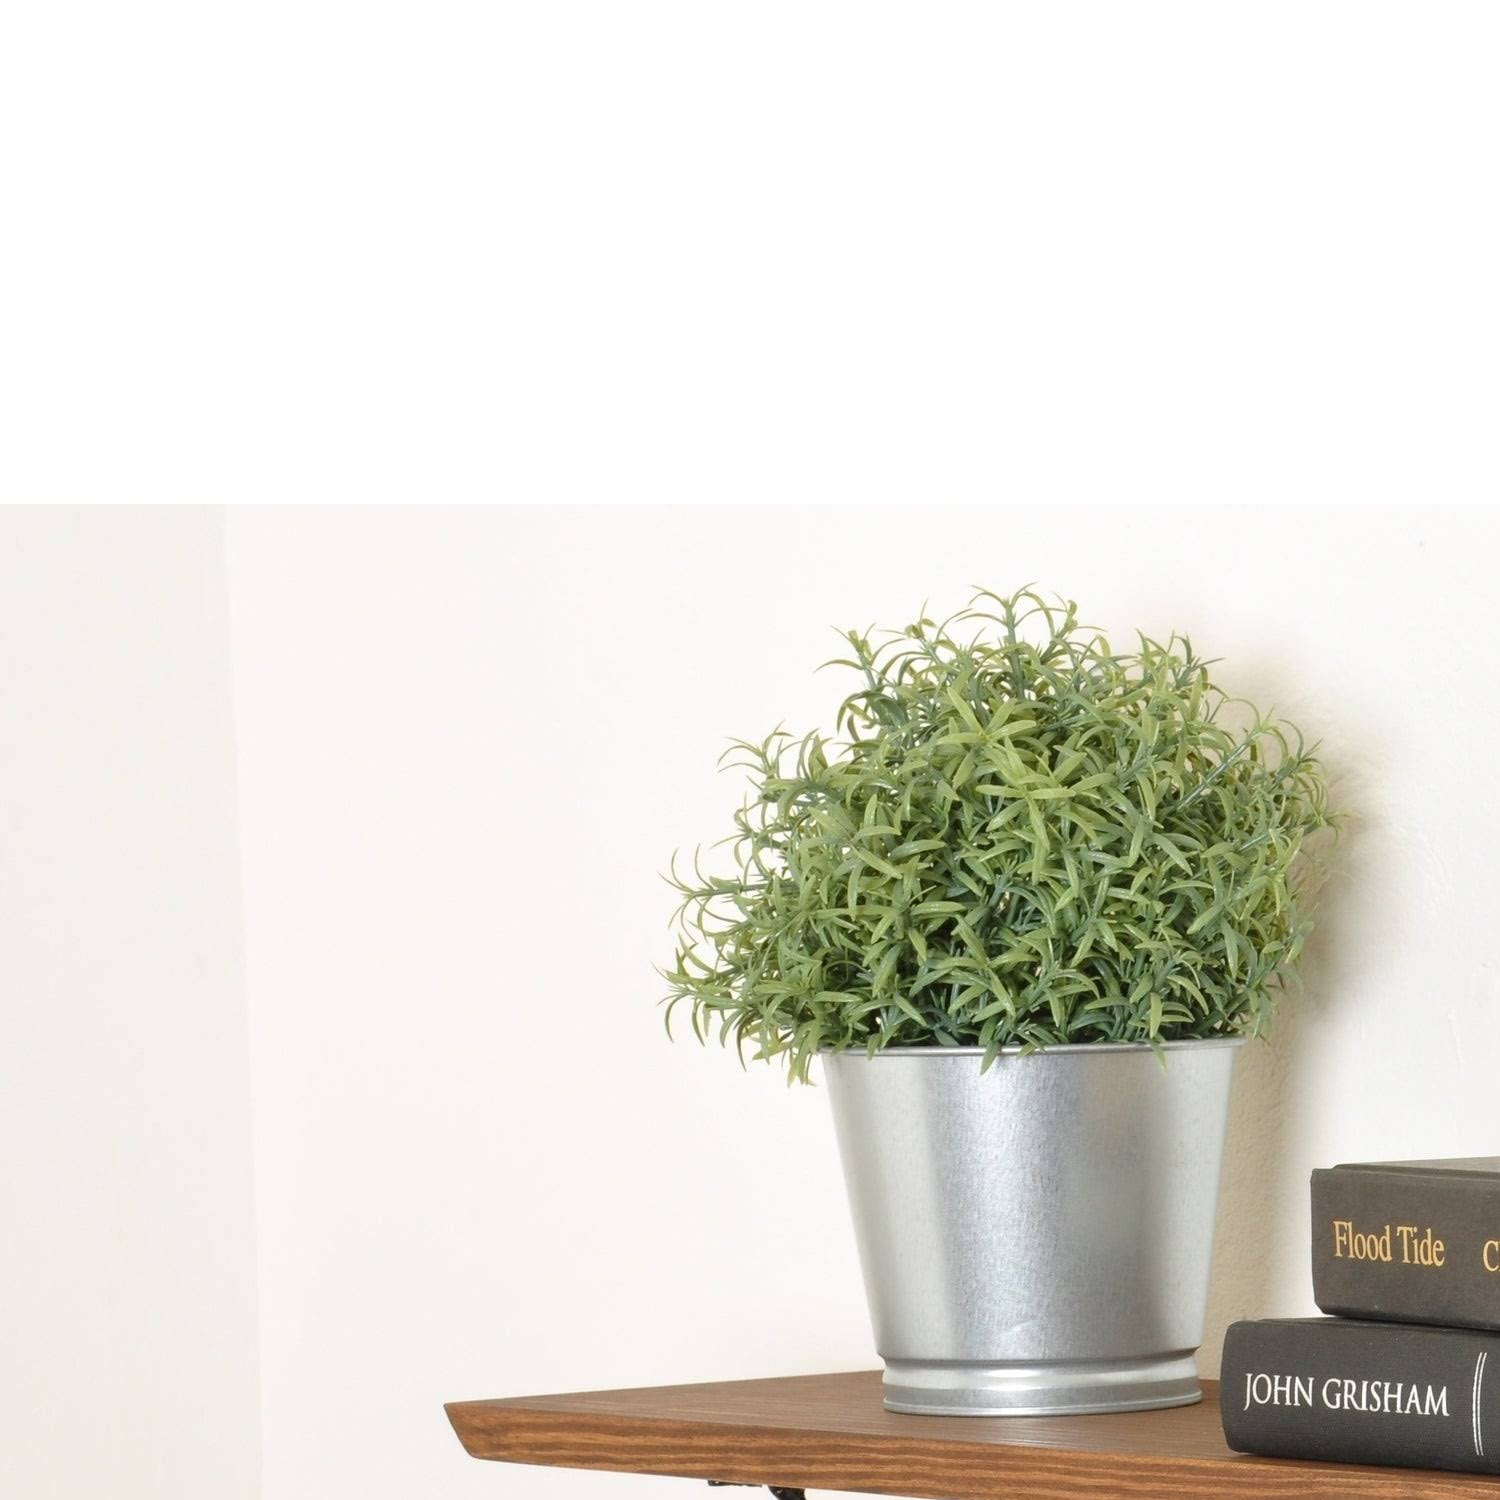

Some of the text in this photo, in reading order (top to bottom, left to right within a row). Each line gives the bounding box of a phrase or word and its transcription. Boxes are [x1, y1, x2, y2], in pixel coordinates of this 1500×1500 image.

[1333, 1220, 1445, 1267] Flood Tide
[1244, 1372, 1450, 1417] JOHN GRISHAM
